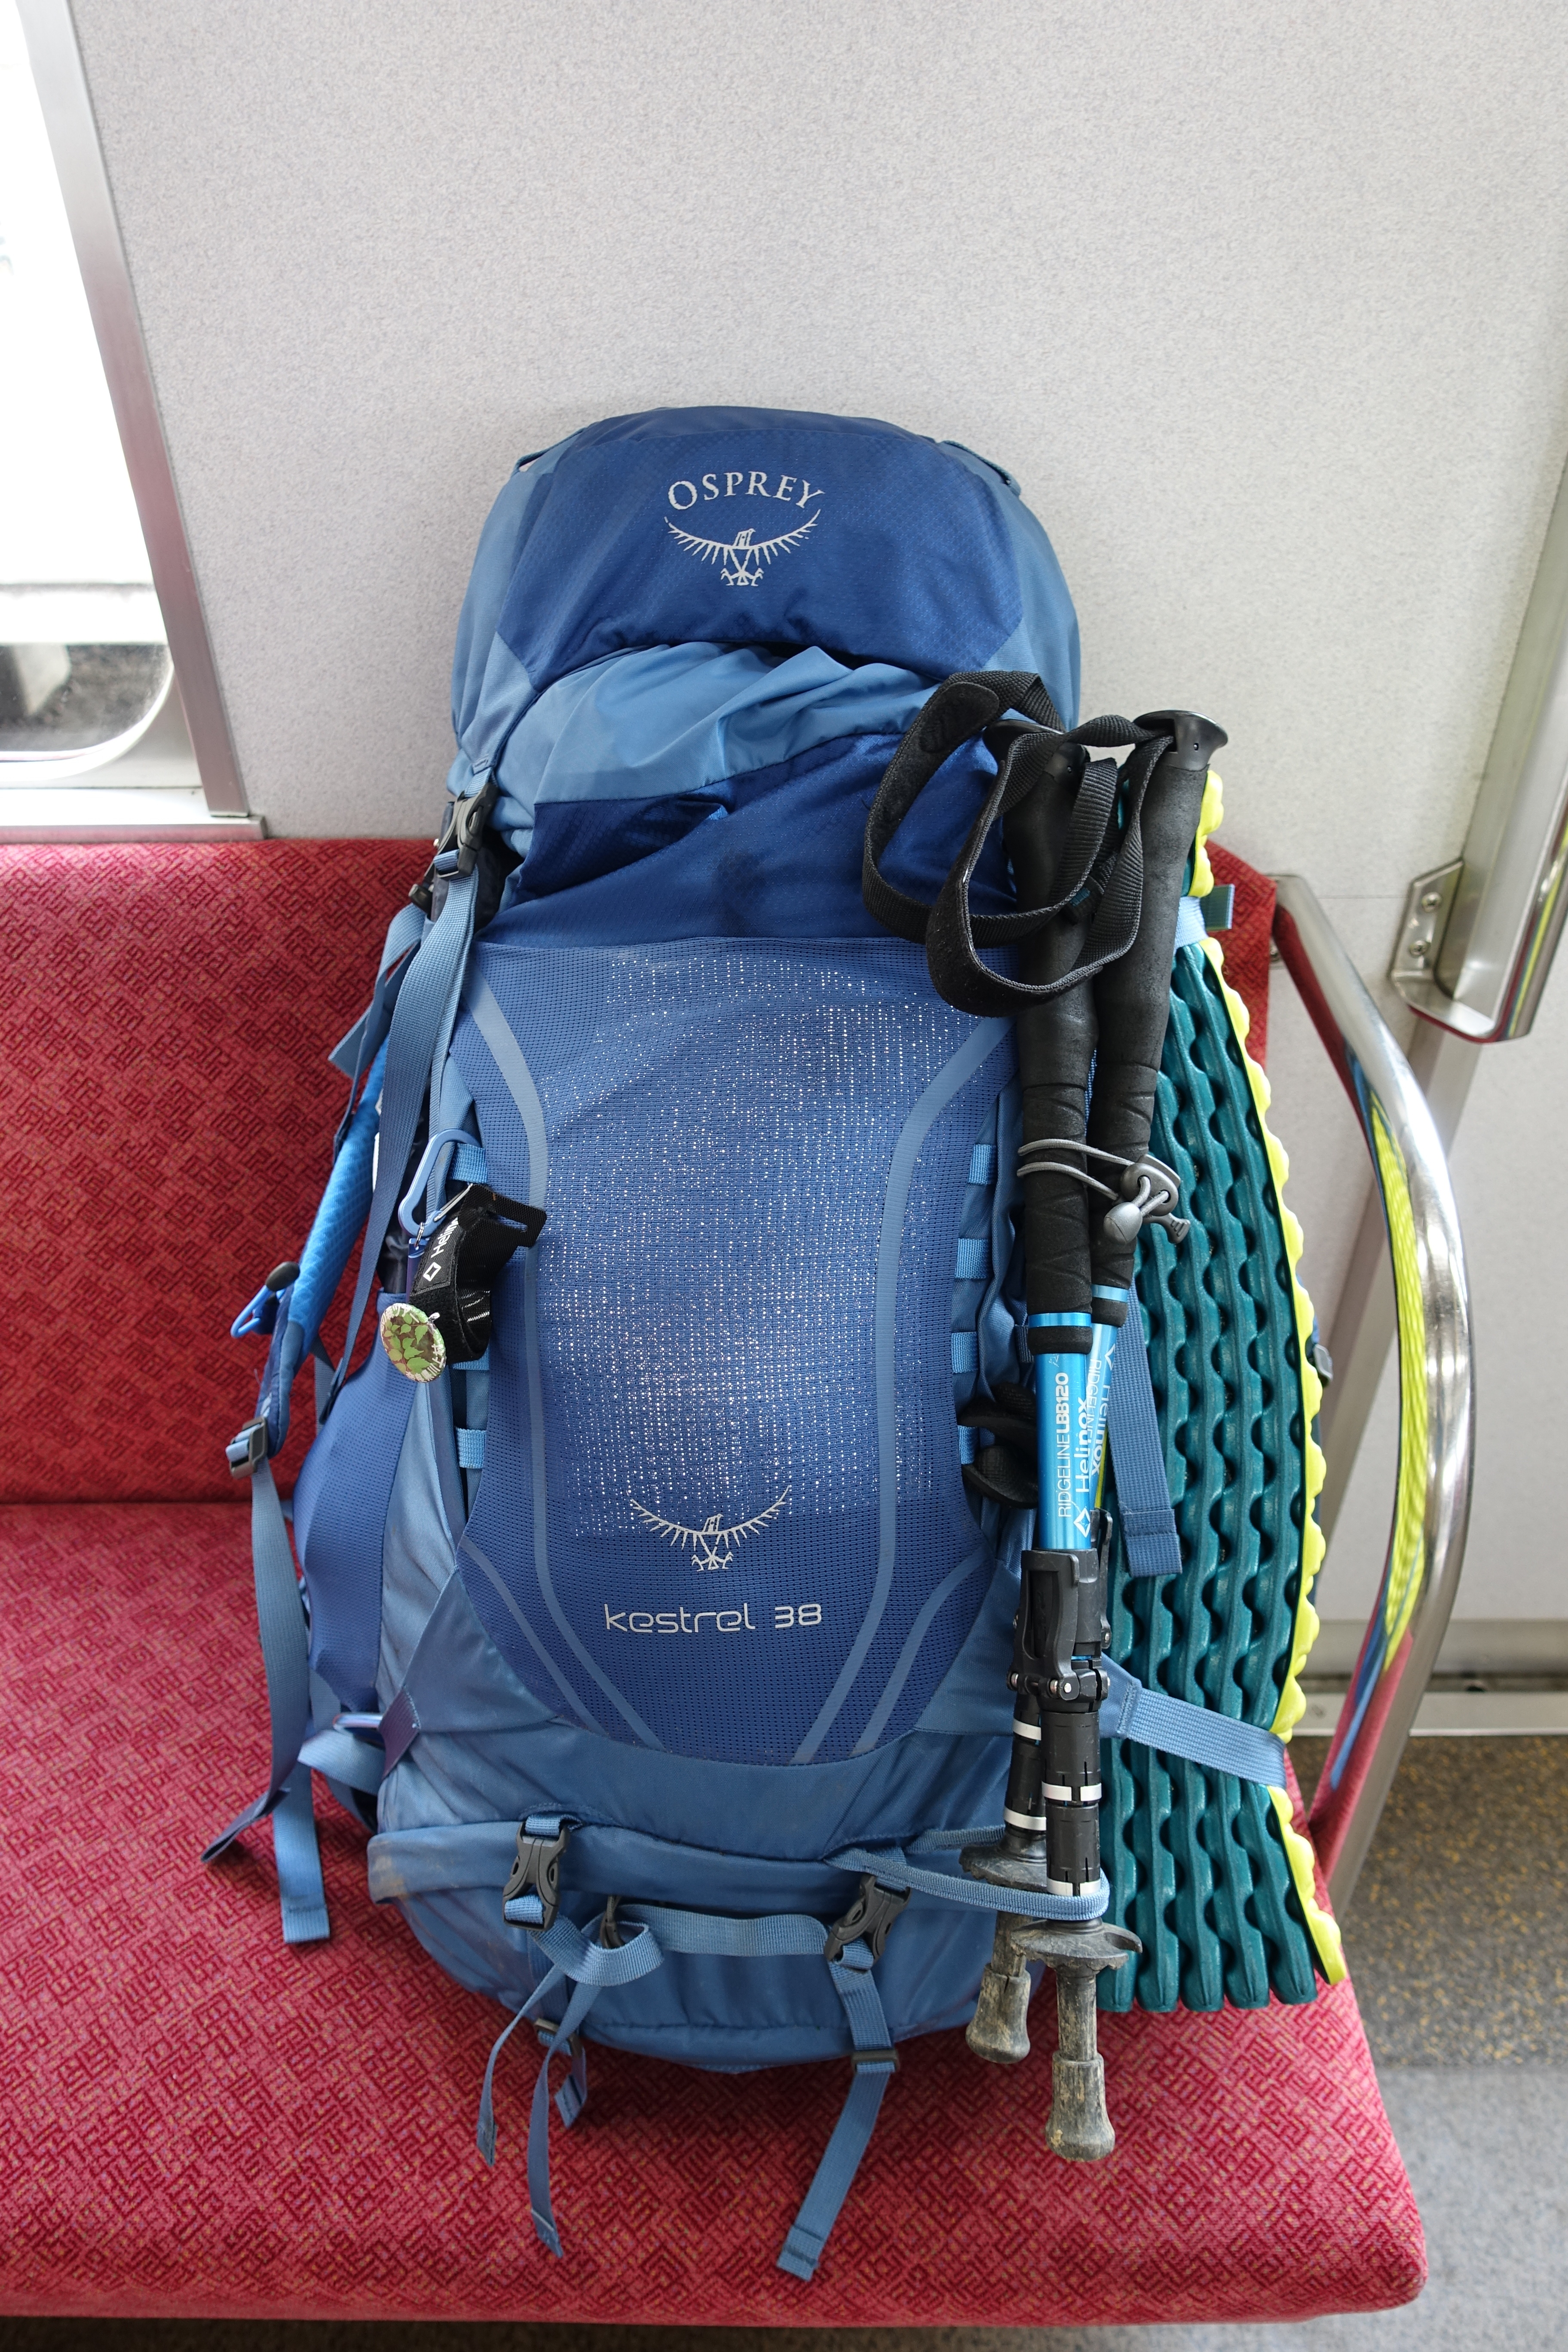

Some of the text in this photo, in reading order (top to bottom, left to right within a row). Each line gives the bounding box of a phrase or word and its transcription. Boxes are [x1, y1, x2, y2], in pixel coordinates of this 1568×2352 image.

[668, 472, 825, 510] OSPREY
[1074, 1397, 1091, 1492] Helinox
[604, 1603, 822, 1633] kestrel 38
